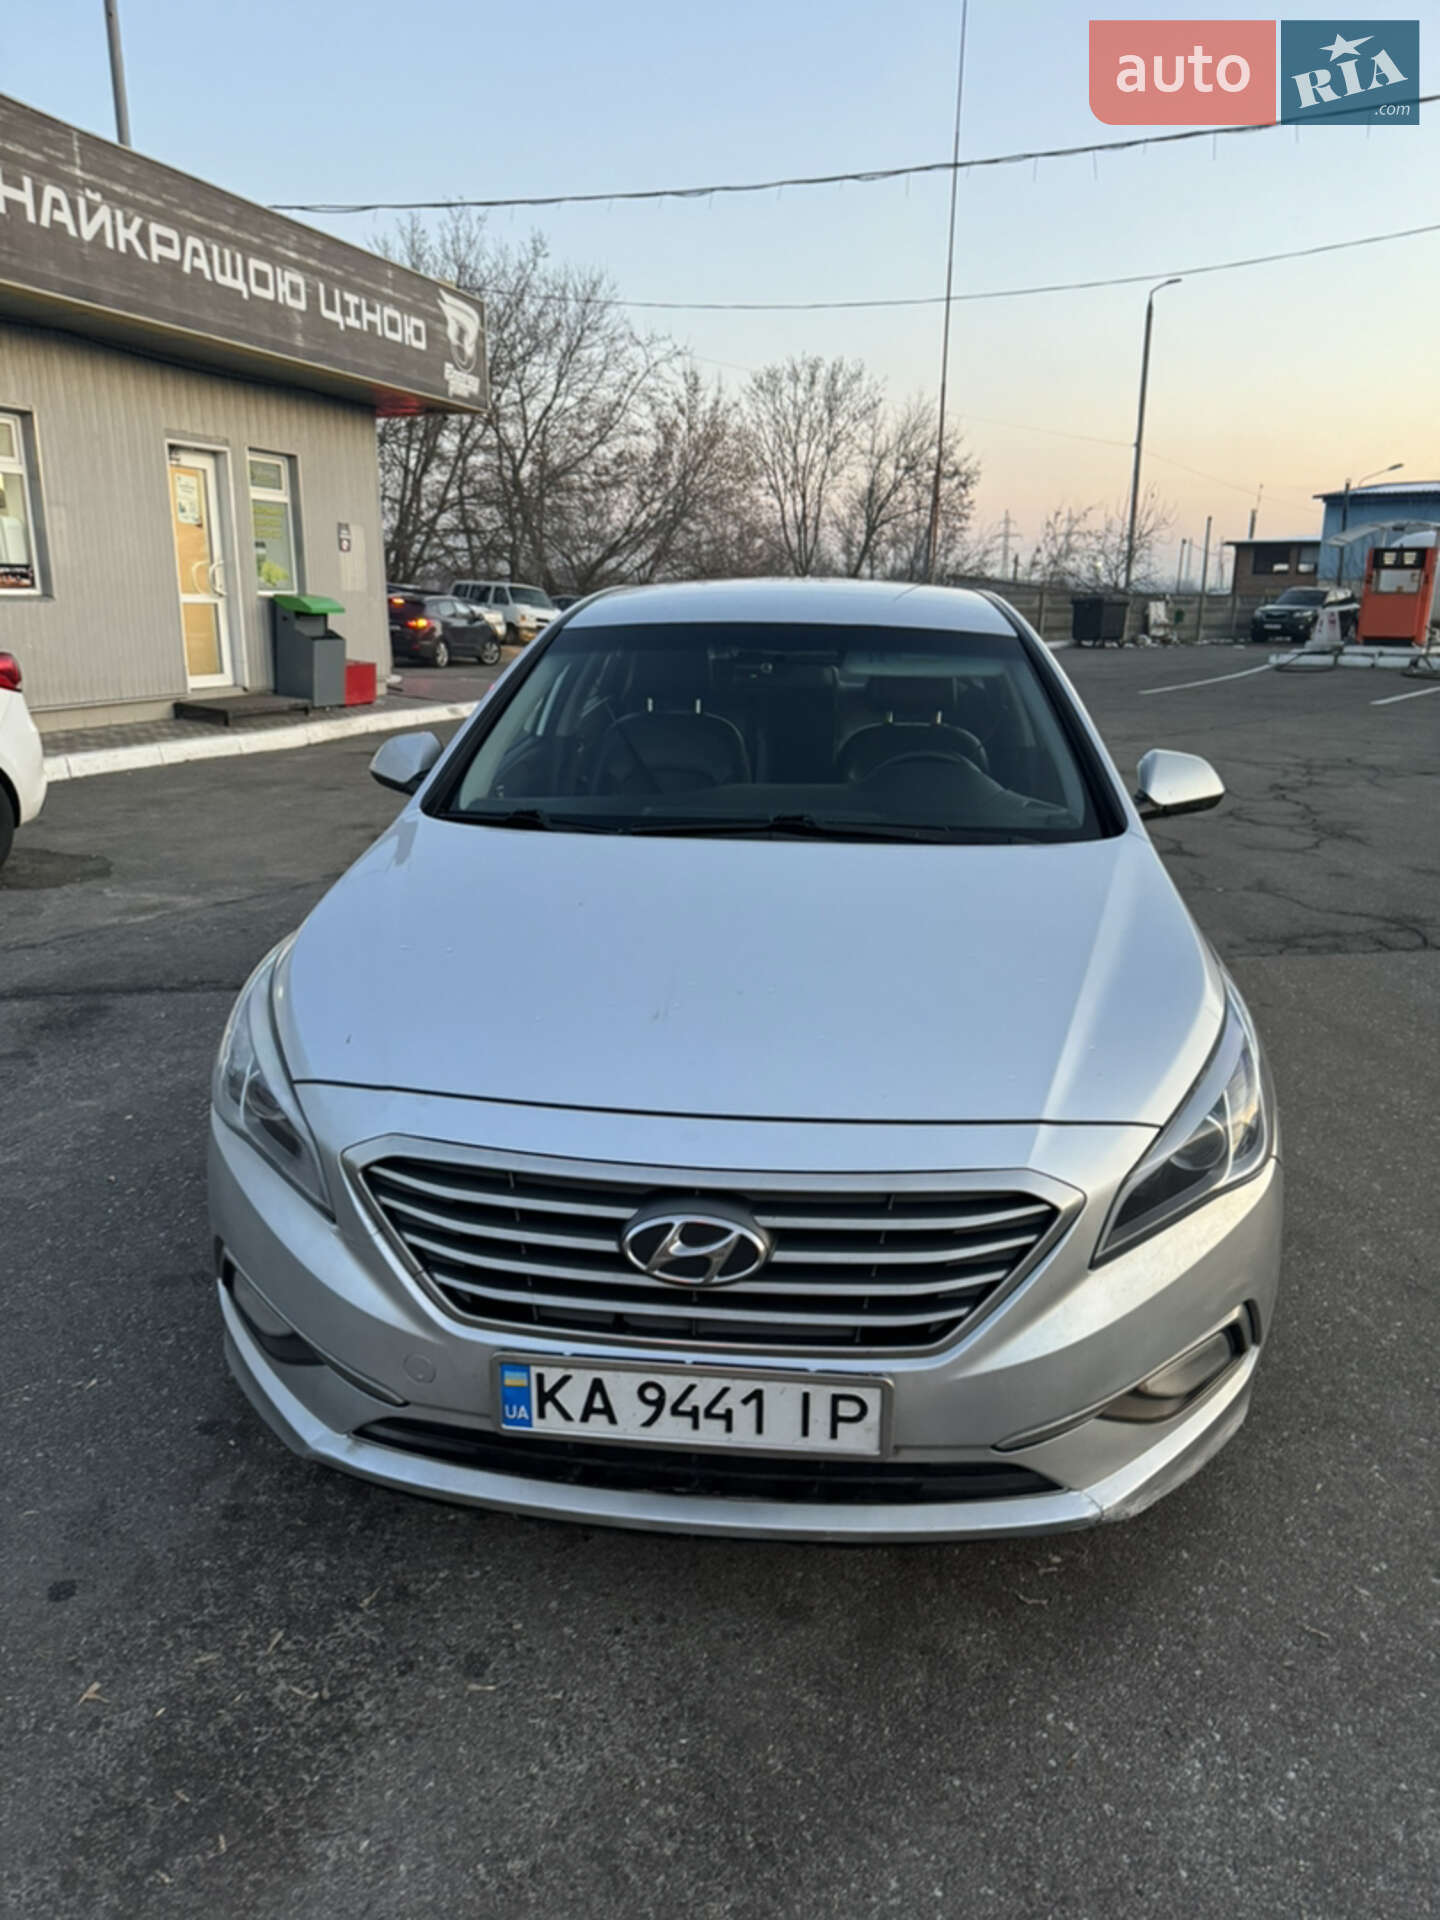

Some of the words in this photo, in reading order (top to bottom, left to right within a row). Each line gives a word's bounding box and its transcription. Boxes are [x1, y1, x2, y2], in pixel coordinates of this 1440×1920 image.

[0, 167, 307, 311] НАЙКРАЩОЮ
[319, 282, 427, 350] ЦІНОЮ
[505, 1404, 529, 1420] UA
[536, 1372, 618, 1426] KA
[637, 1381, 764, 1435] 9441
[801, 1391, 868, 1439] IP
